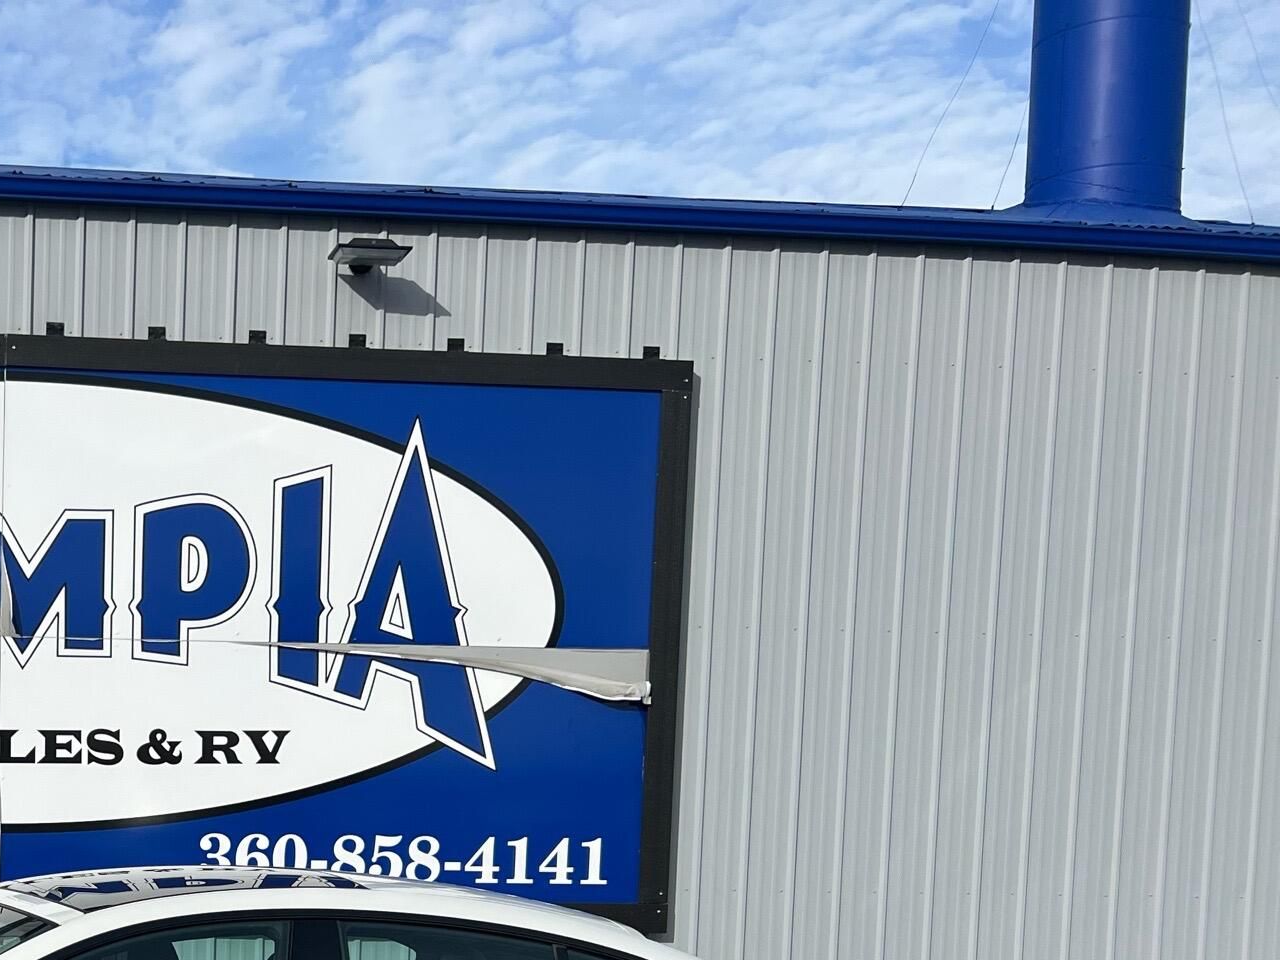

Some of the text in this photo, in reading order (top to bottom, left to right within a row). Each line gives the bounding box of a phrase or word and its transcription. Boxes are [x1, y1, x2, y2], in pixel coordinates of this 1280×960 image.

[136, 728, 184, 766] &
[193, 729, 292, 766] RV
[199, 832, 608, 886] 360-858-4141
